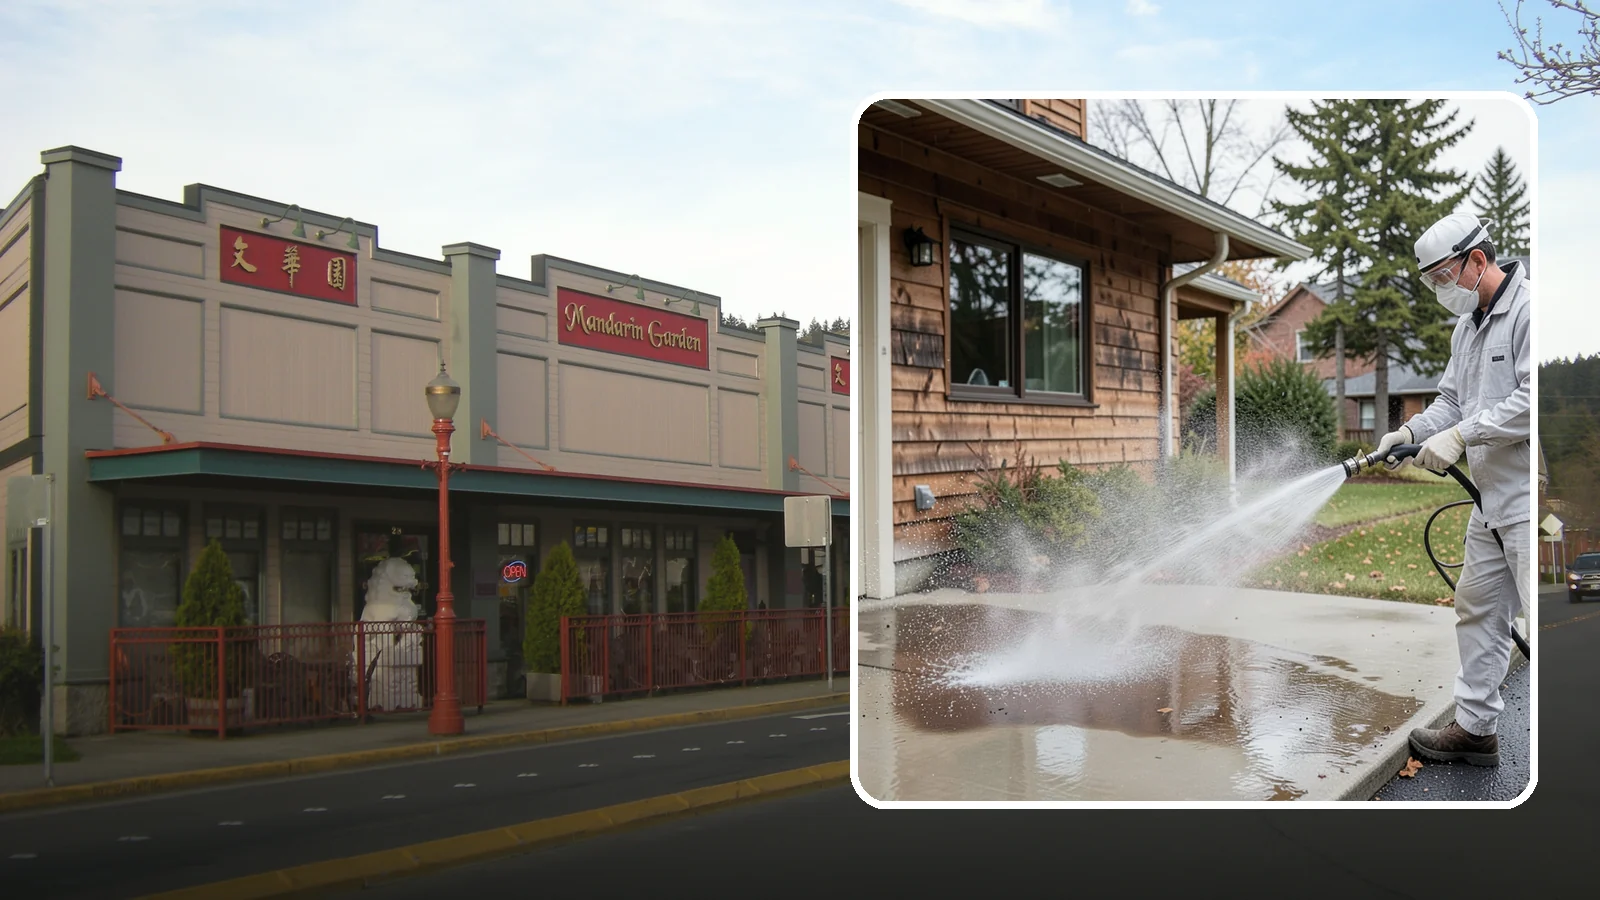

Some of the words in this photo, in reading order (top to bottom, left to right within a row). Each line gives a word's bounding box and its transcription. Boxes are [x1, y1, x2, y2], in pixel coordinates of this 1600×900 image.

[564, 302, 644, 341] Mandarin
[647, 320, 702, 352] Garden
[503, 565, 527, 578] OPEN
